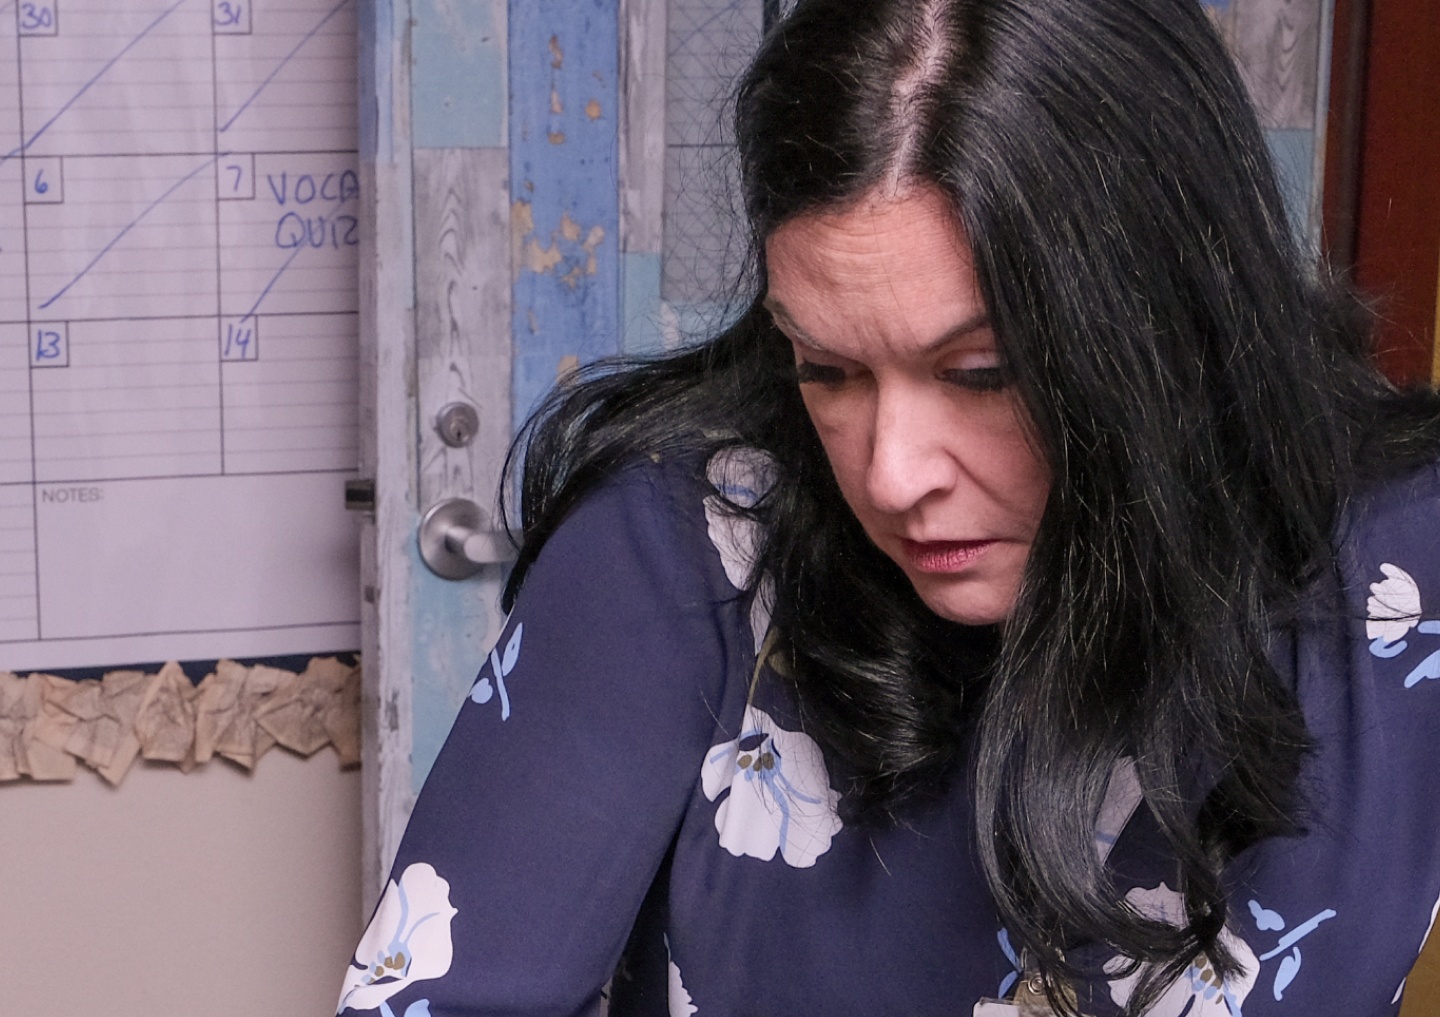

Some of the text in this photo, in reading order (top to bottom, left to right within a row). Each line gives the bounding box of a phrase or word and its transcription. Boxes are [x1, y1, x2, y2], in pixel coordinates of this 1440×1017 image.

[21, 2, 52, 29] 30
[214, 1, 241, 26] 31
[33, 168, 49, 195] 6
[226, 165, 242, 192] 7
[275, 212, 359, 249] QUIZ
[35, 330, 60, 361] 13
[224, 324, 251, 357] 14
[41, 486, 104, 503] NOTES:
